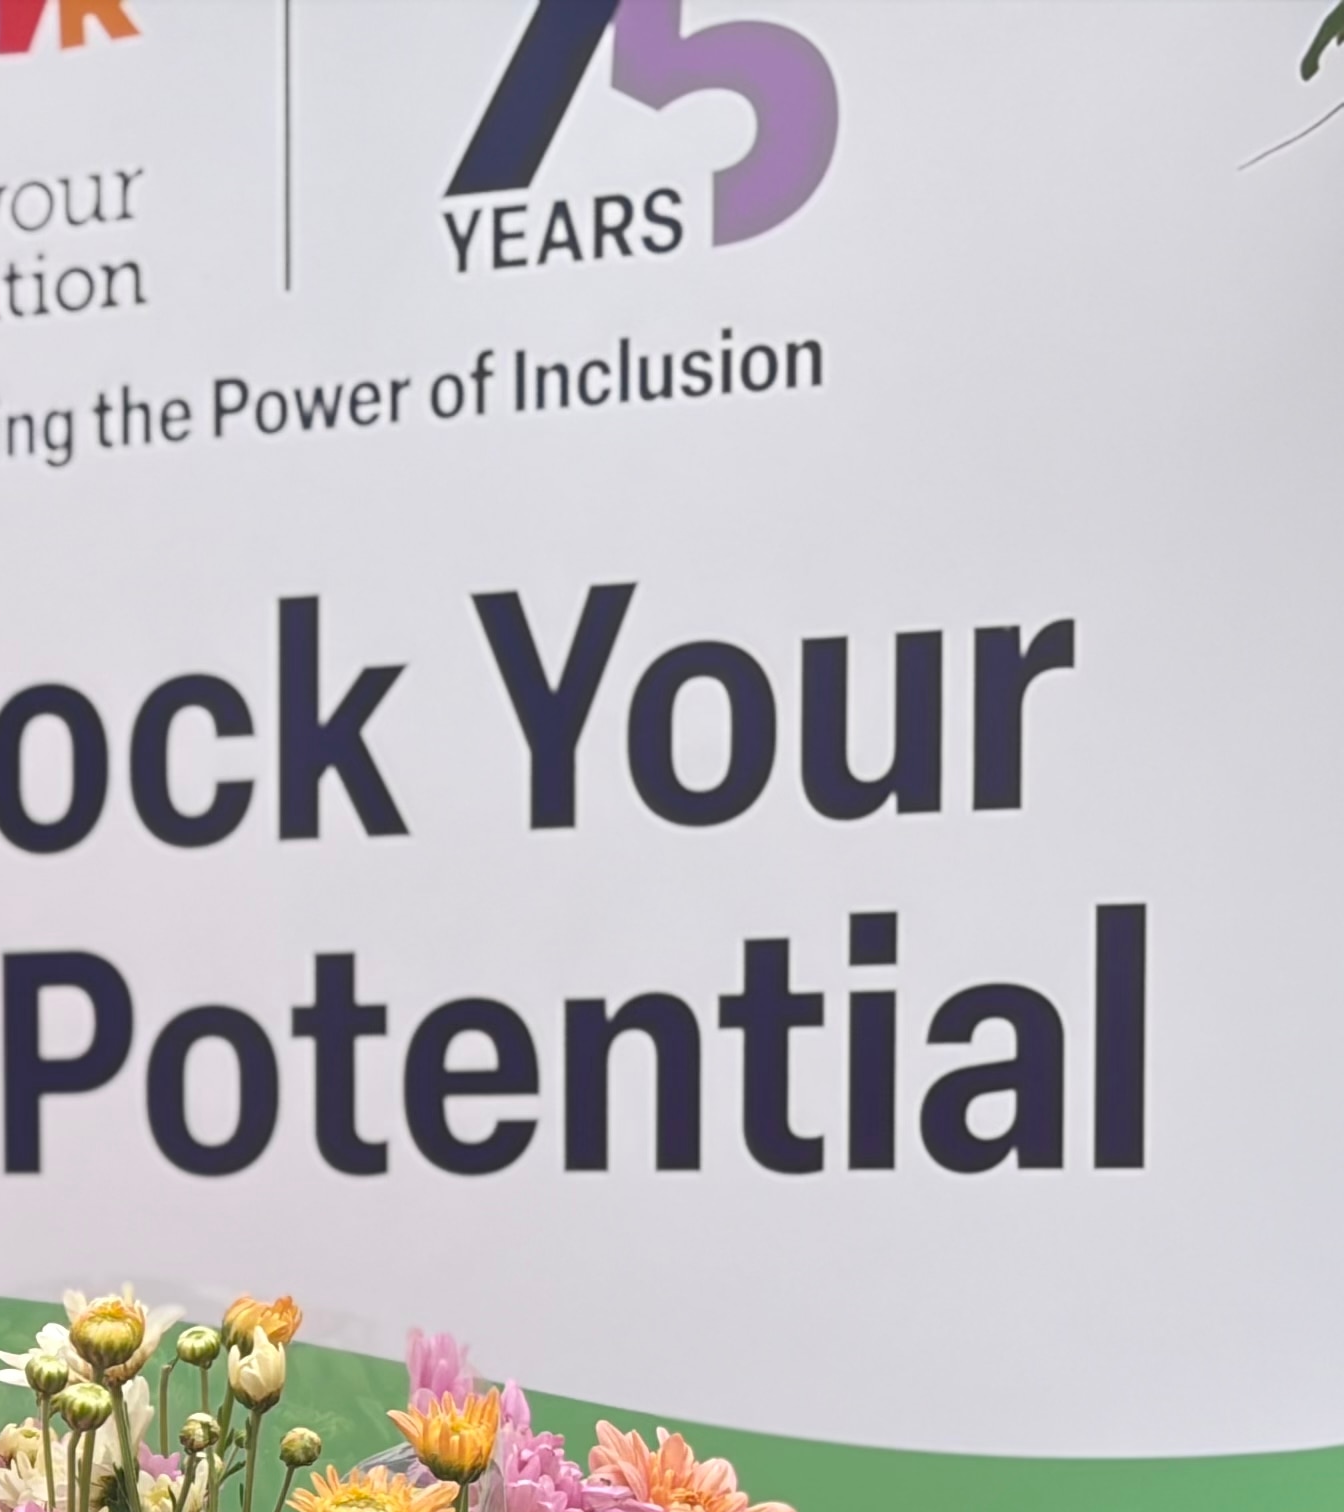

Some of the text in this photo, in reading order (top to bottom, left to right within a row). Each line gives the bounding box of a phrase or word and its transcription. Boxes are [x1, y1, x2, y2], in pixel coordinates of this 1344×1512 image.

[443, 0, 839, 248] 75
[443, 187, 683, 273] YEARS
[92, 385, 192, 448] the
[212, 376, 411, 438] Power
[430, 349, 494, 419] of
[515, 328, 824, 412] Inclusion
[470, 581, 1075, 830] Your
[2, 903, 1146, 1177] Potential
